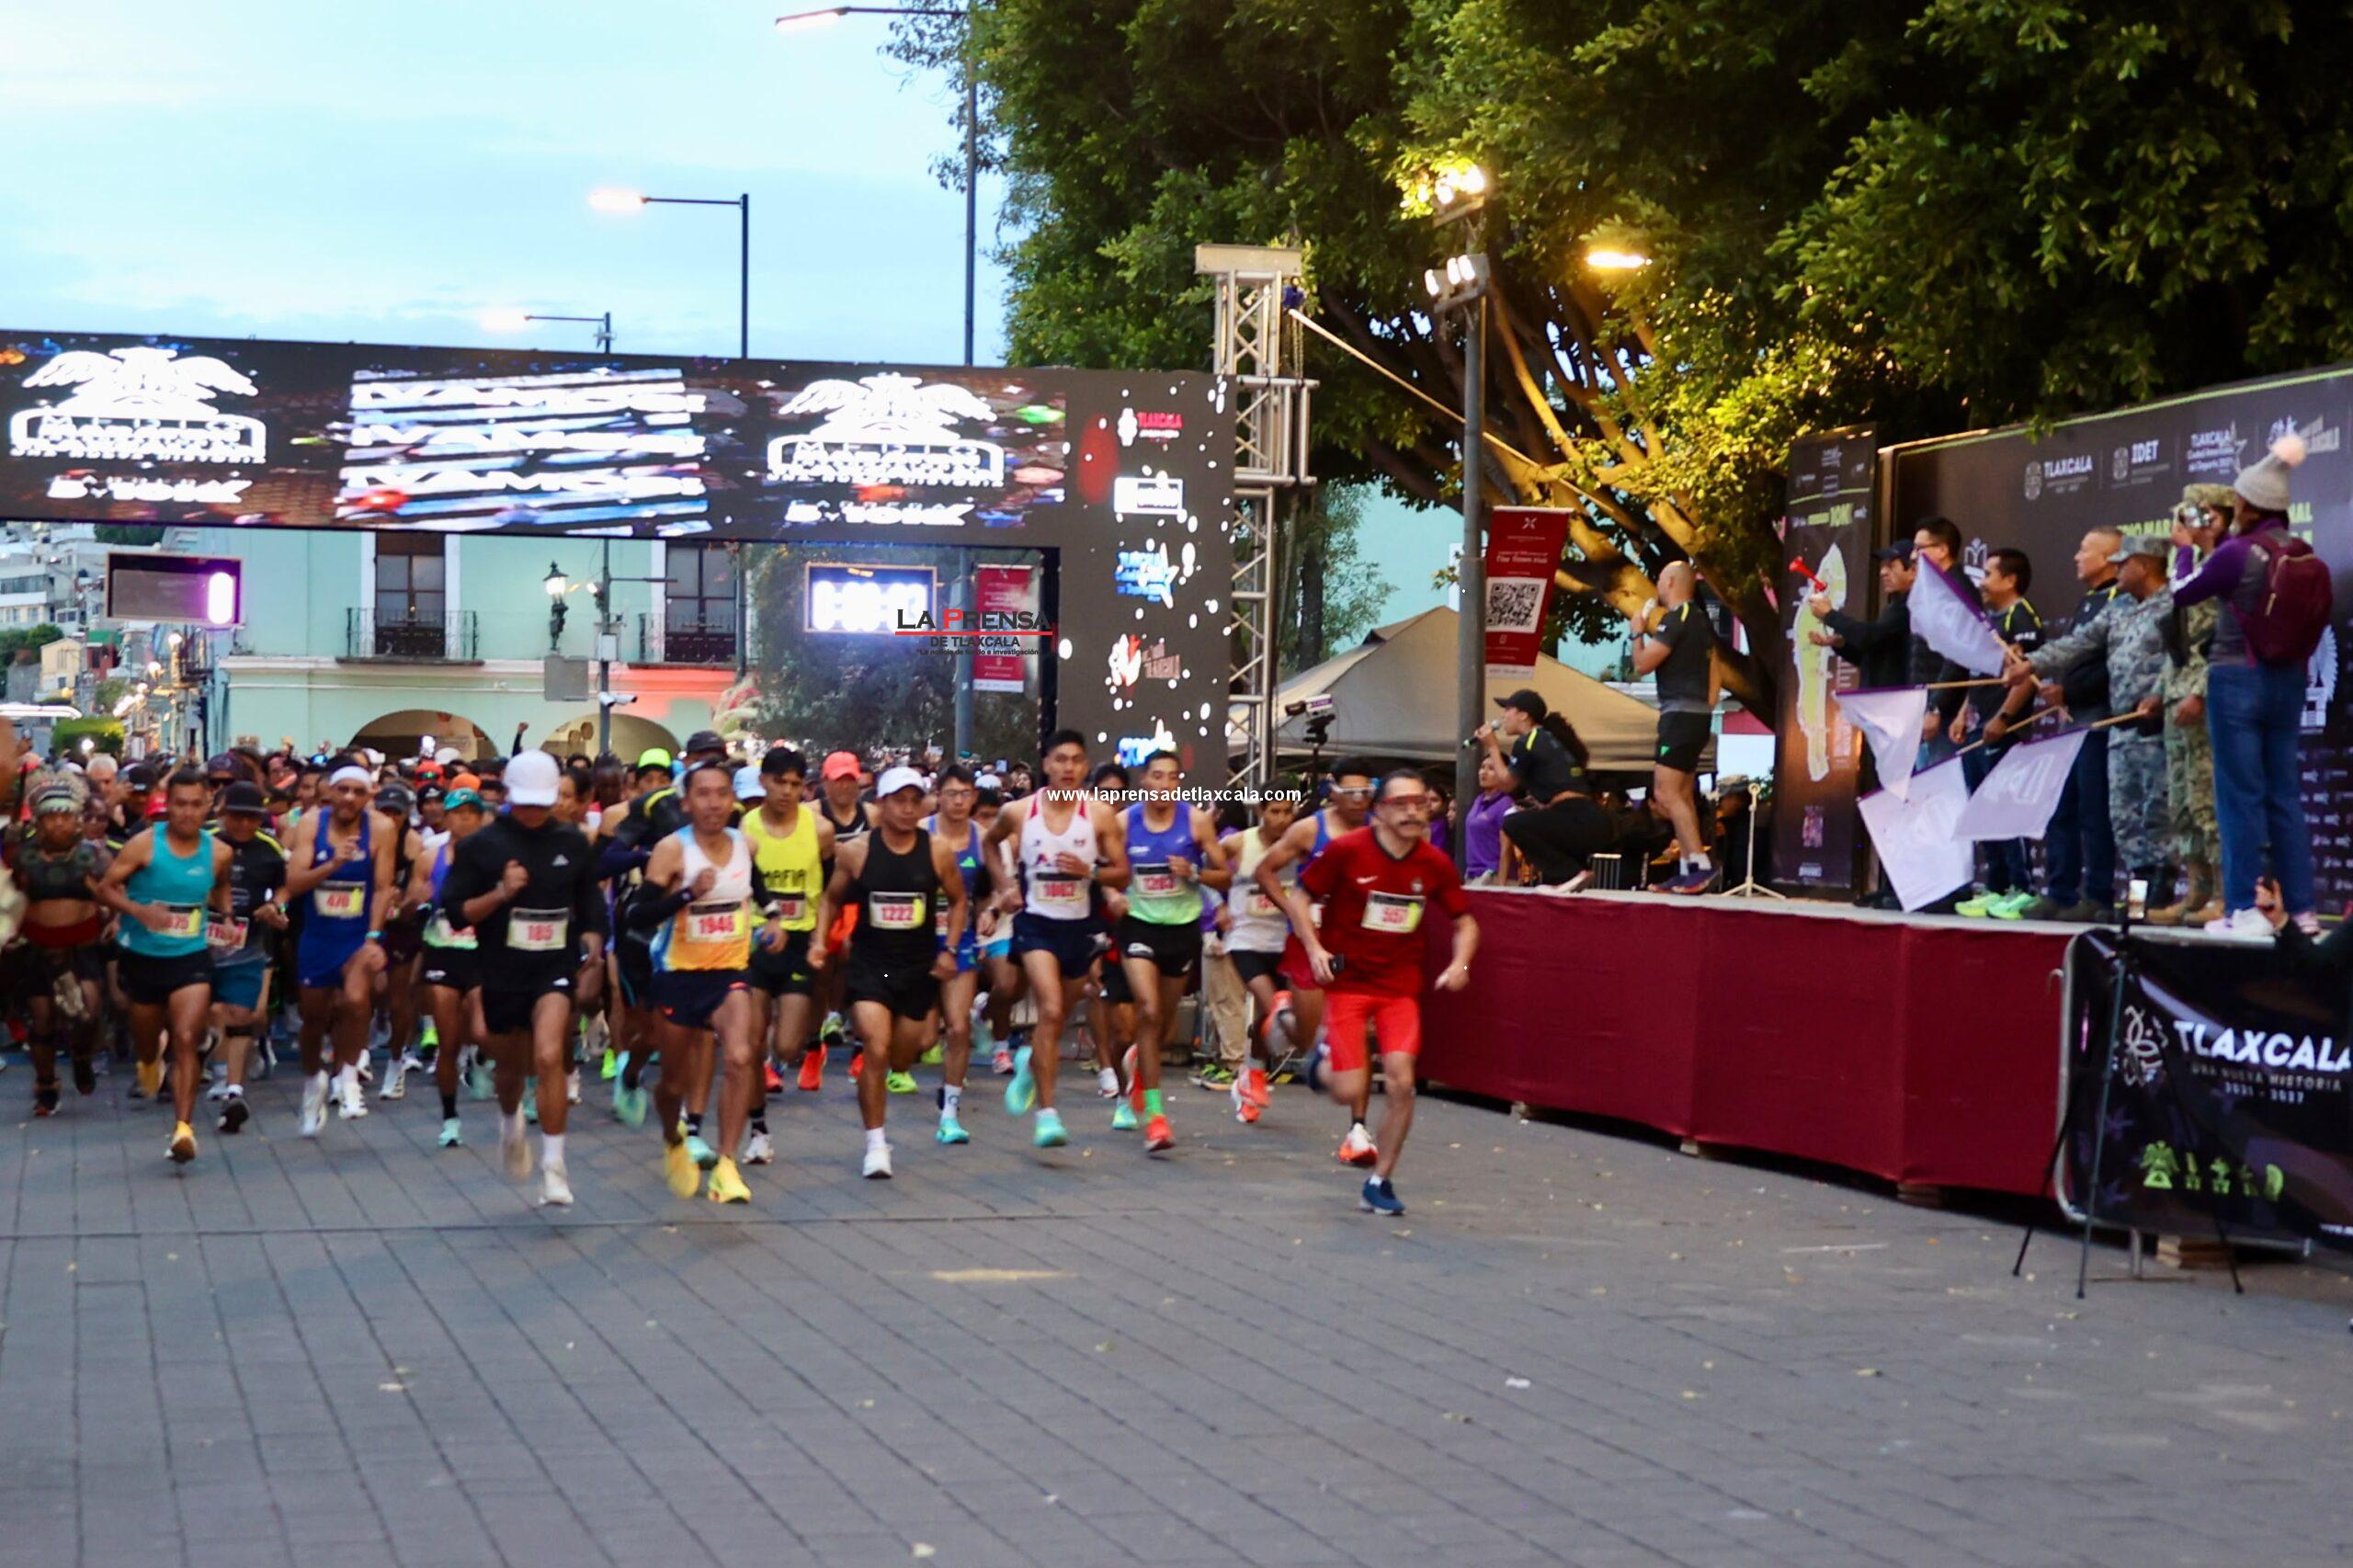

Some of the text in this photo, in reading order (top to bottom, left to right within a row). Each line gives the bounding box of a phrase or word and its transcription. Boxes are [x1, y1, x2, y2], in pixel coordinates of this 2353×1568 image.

[2043, 454, 2094, 478] TLAXCALA
[2172, 1019, 2352, 1073] TLAXCALA
[2268, 1072, 2342, 1092] HISTORIA
